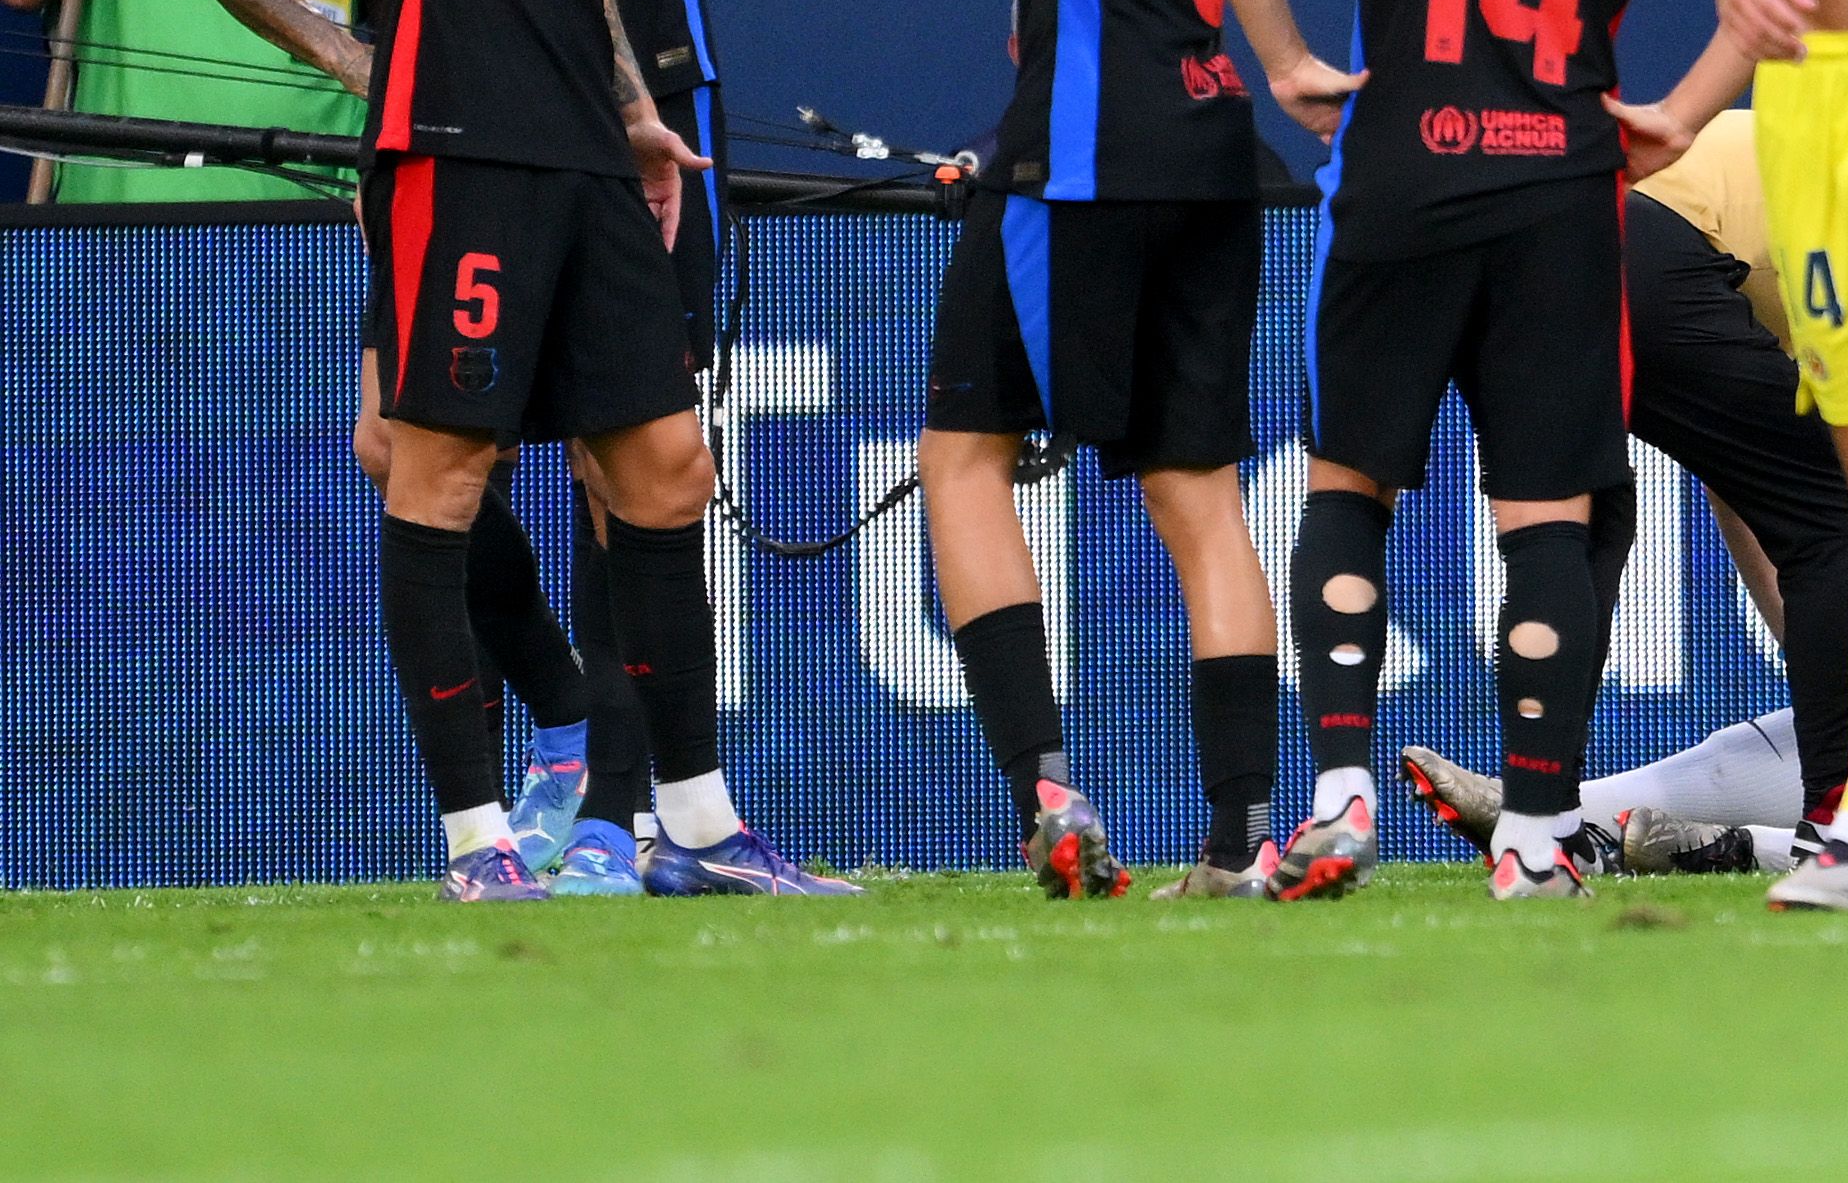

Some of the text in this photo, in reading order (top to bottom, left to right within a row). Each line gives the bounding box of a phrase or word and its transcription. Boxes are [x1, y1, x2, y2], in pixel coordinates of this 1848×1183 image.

[1481, 110, 1566, 130] UNHCR
[1481, 129, 1566, 149] ACNUR
[453, 253, 501, 339] 5
[1805, 250, 1844, 328] 4
